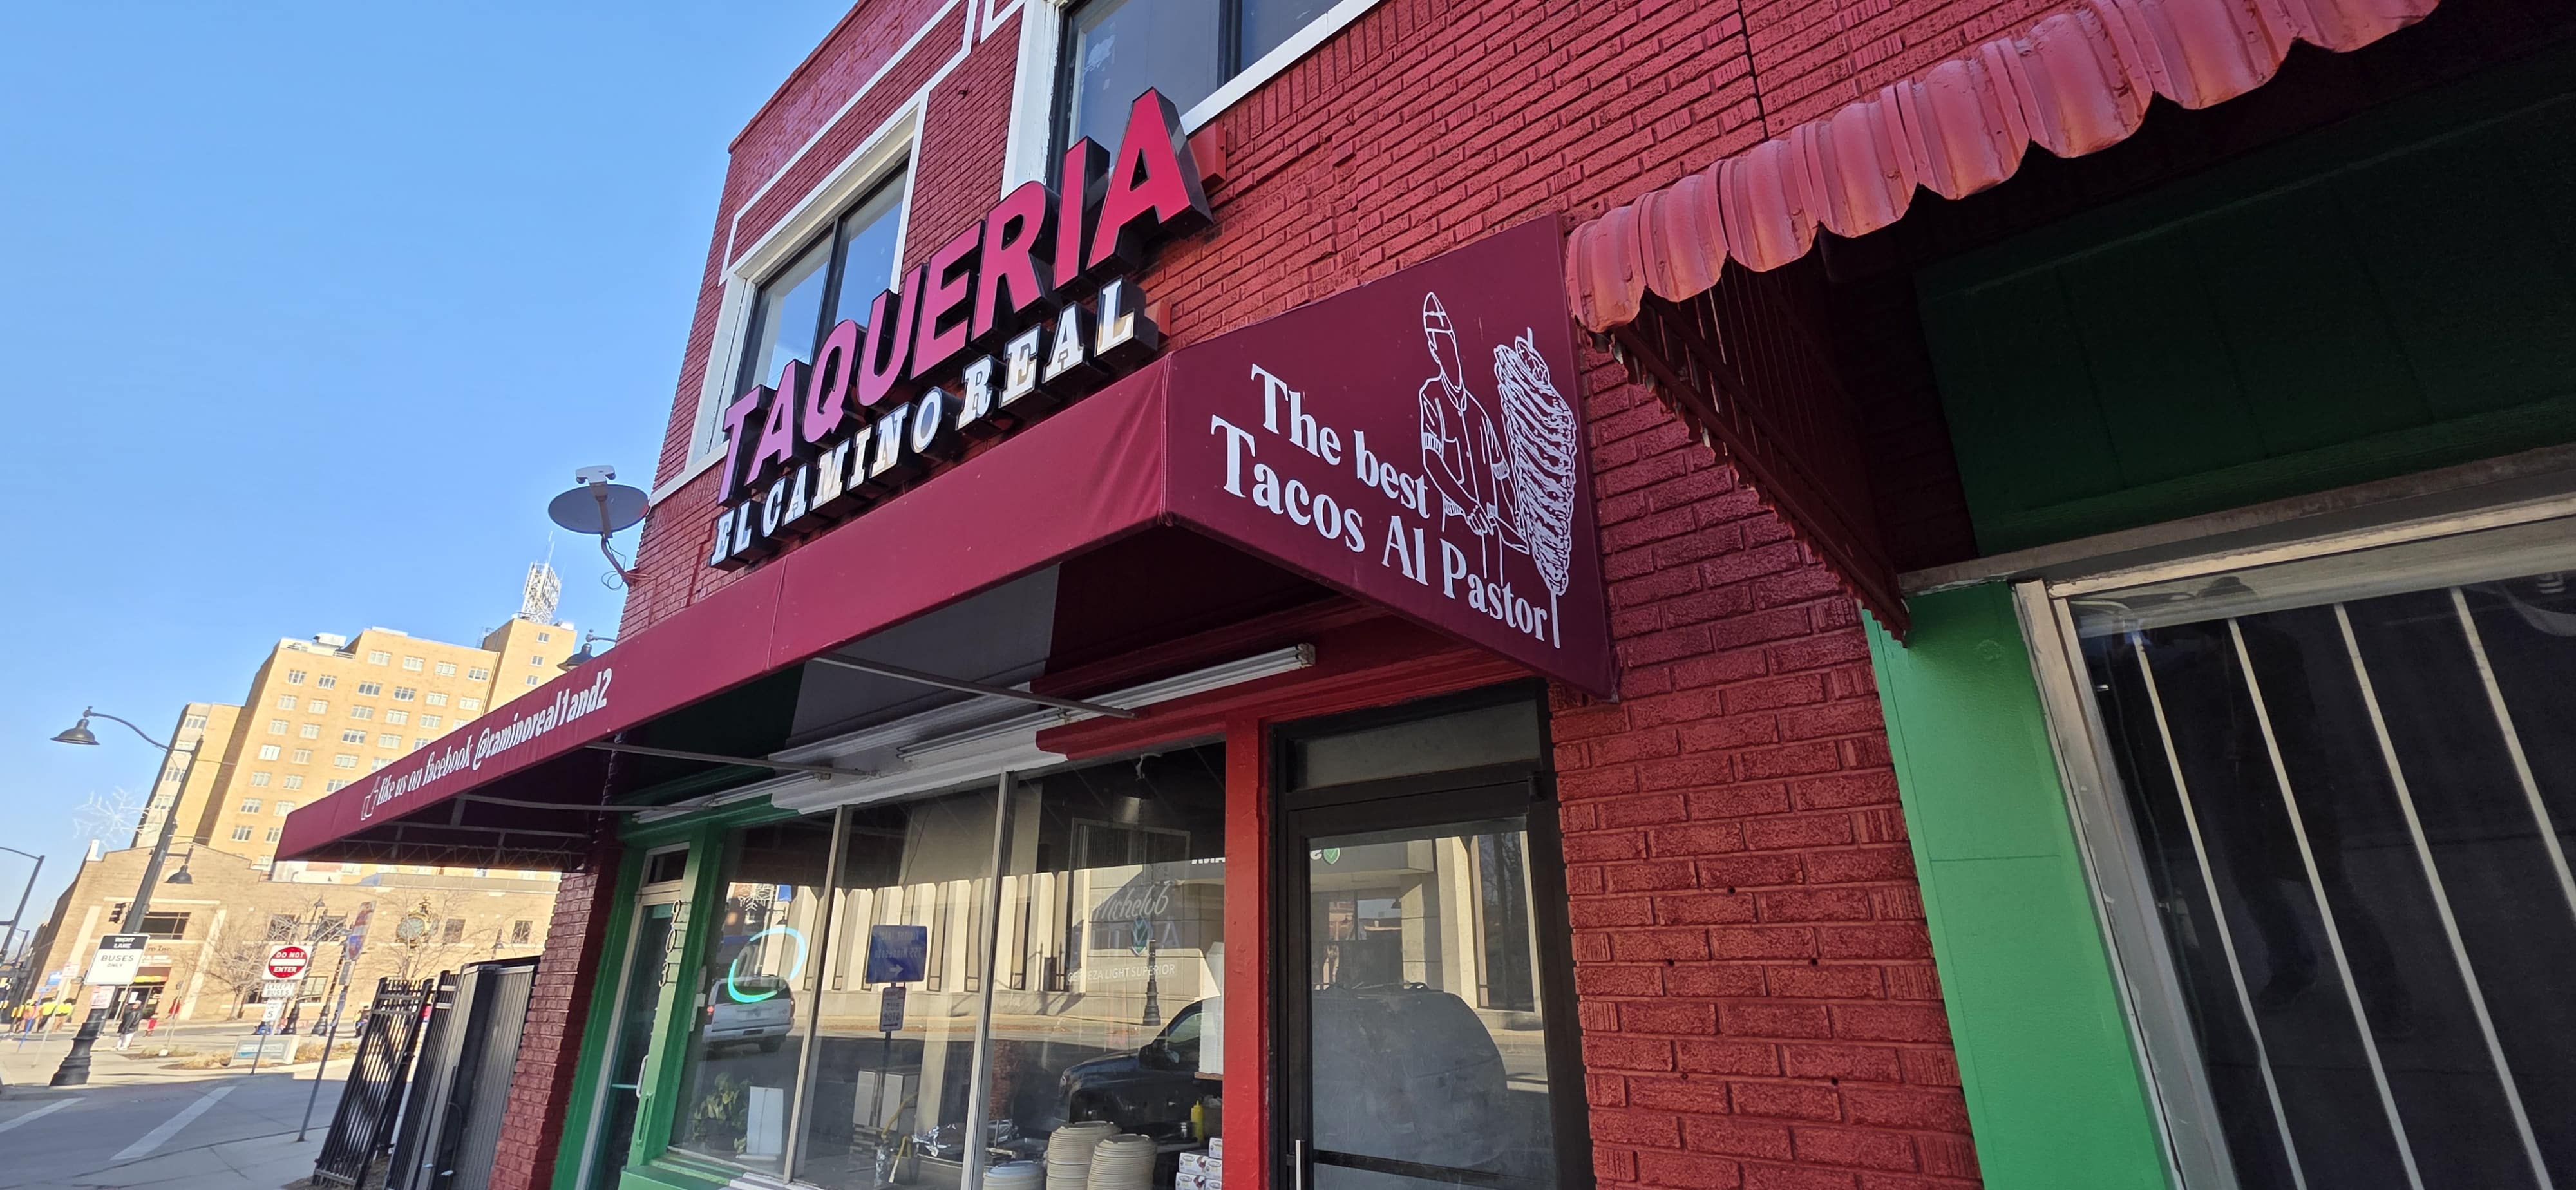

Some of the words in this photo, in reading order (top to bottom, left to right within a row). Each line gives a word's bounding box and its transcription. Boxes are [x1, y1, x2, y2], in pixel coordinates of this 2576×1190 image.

[717, 88, 1193, 505] TAQUERIA
[710, 506, 752, 567] EL
[761, 386, 942, 538] CAMINO
[956, 277, 1135, 431] REAL
[1251, 364, 1341, 465] The
[1354, 430, 1430, 519] best
[1211, 414, 1366, 552] Tacos
[1382, 515, 1429, 586] Al
[1440, 538, 1548, 641] Pastor
[377, 775, 395, 806] like
[395, 775, 408, 797] us
[408, 768, 423, 792] on
[422, 735, 473, 786] facebook
[472, 668, 612, 771] @caminoreal1and2
[659, 900, 681, 987] 903
[1068, 970, 1103, 983] CEEZA
[1104, 968, 1130, 979] LIGHT
[1131, 964, 1175, 977] SUPERIOR
